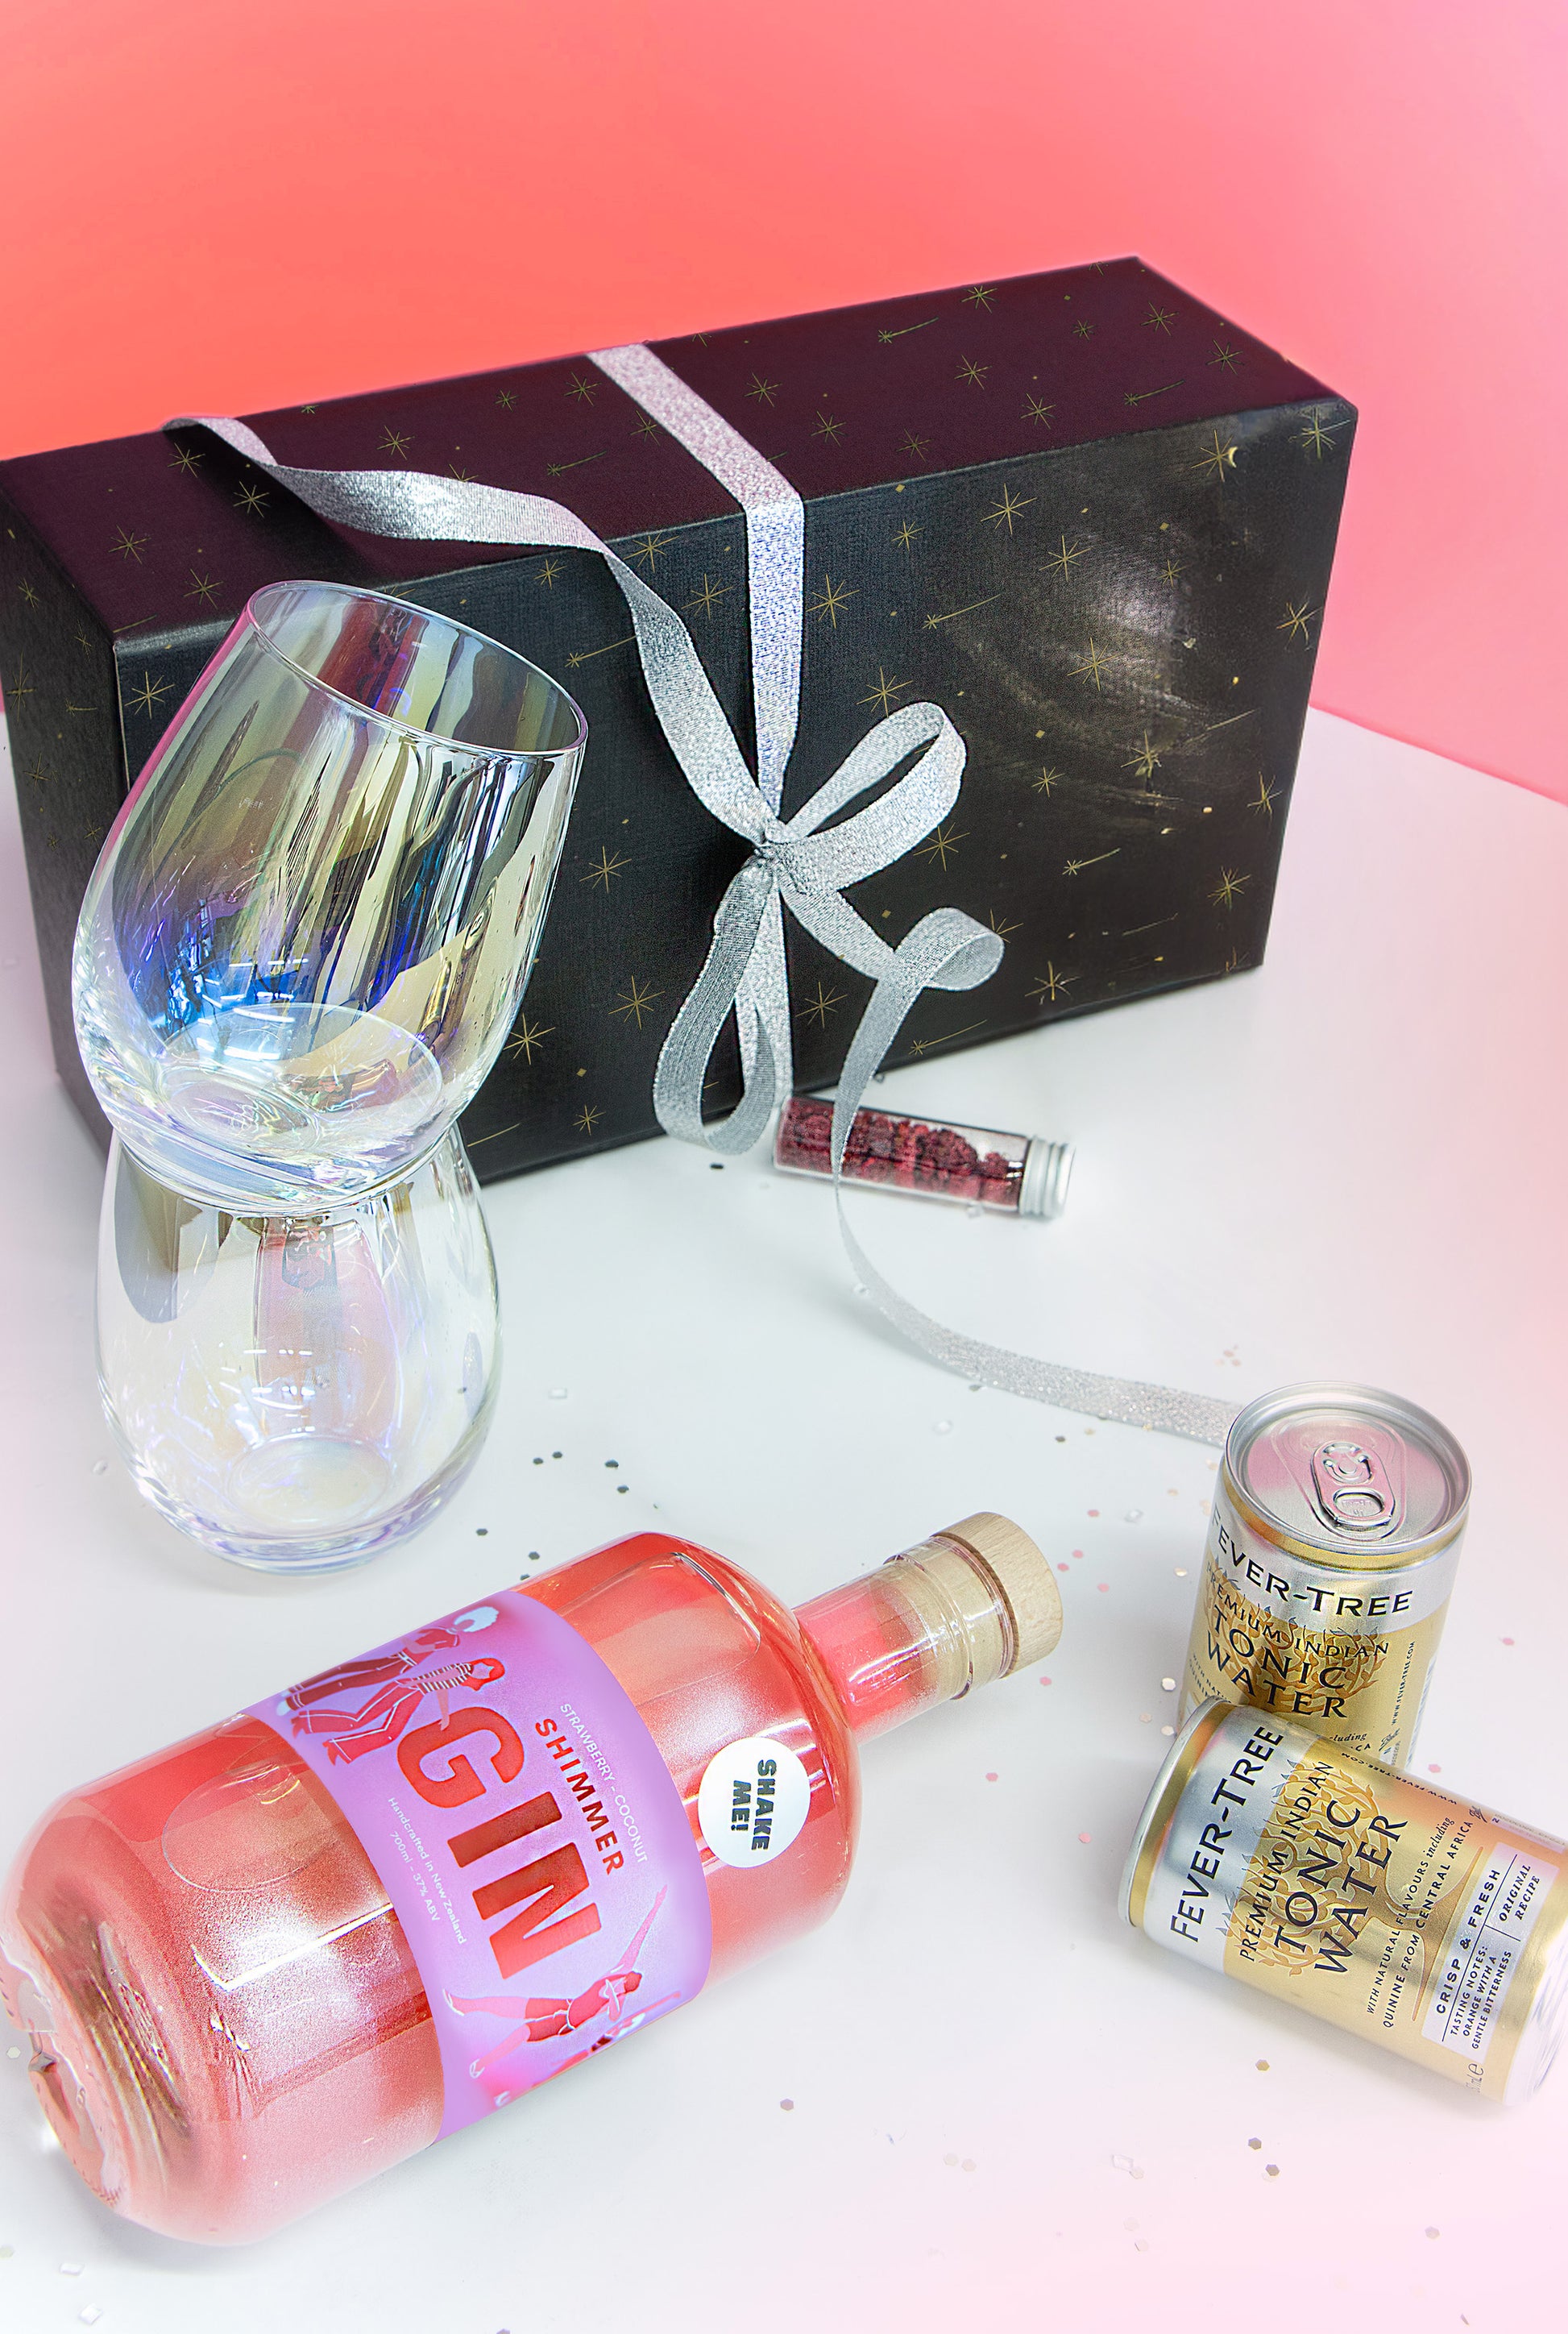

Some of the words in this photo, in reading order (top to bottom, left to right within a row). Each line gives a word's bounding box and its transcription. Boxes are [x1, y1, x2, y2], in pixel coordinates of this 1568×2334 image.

[1207, 1561, 1282, 1644] PREMIUM
[1294, 1638, 1390, 1657] INDIAN
[1212, 1505, 1413, 1617] FEVER-TREE
[1207, 1630, 1348, 1718] WATER
[1214, 1604, 1347, 1689] TONIC
[535, 1718, 624, 1875] SHIMMER
[560, 1703, 616, 1783] STRAWBERRY
[615, 1794, 649, 1864] COCONUT
[731, 1780, 752, 1832] ME!
[751, 1759, 778, 1850] SHAKE
[1170, 1726, 1284, 1943] FEVER-TREE
[388, 1796, 429, 1862] Handcrafted
[426, 1860, 436, 1874] in
[432, 1874, 446, 1897] New
[442, 1895, 468, 1944] Zealand
[389, 1830, 412, 1865] 700ml
[413, 1873, 427, 1897] 37%
[425, 1896, 441, 1921] ABV
[396, 1706, 603, 1980] GIN
[1240, 1850, 1289, 1962] PREMIUM
[1280, 1761, 1334, 1840] INDIAN
[1274, 1800, 1361, 1954] TONIC
[1314, 1814, 1408, 1974] WATER
[1500, 1863, 1532, 1923] ORIGINAL
[1515, 1875, 1541, 1921] RECIPE
[1367, 1987, 1380, 2016] WITH
[1375, 1930, 1401, 1987] NATURAL
[1397, 1860, 1429, 1925] FLAVOURS
[1423, 1817, 1455, 1858] including
[1383, 1975, 1408, 2029] QUININE
[1401, 1934, 1420, 1971] FROM
[1417, 1863, 1451, 1929] CENTRAL
[1447, 1821, 1474, 1860] AFRICA
[1436, 1958, 1462, 2015] CRISP
[1460, 1937, 1472, 1950] &
[1467, 1870, 1501, 1929] FRESH
[1450, 1992, 1471, 2037] TASTING
[1466, 1946, 1488, 1990] NOTES:
[1462, 2000, 1482, 2037] ORANGE
[1477, 1969, 1493, 1999] WITH
[1490, 1955, 1498, 1964] A
[1471, 2012, 1488, 2050] GENTLE
[1483, 1950, 1512, 2012] BITTERNESS
